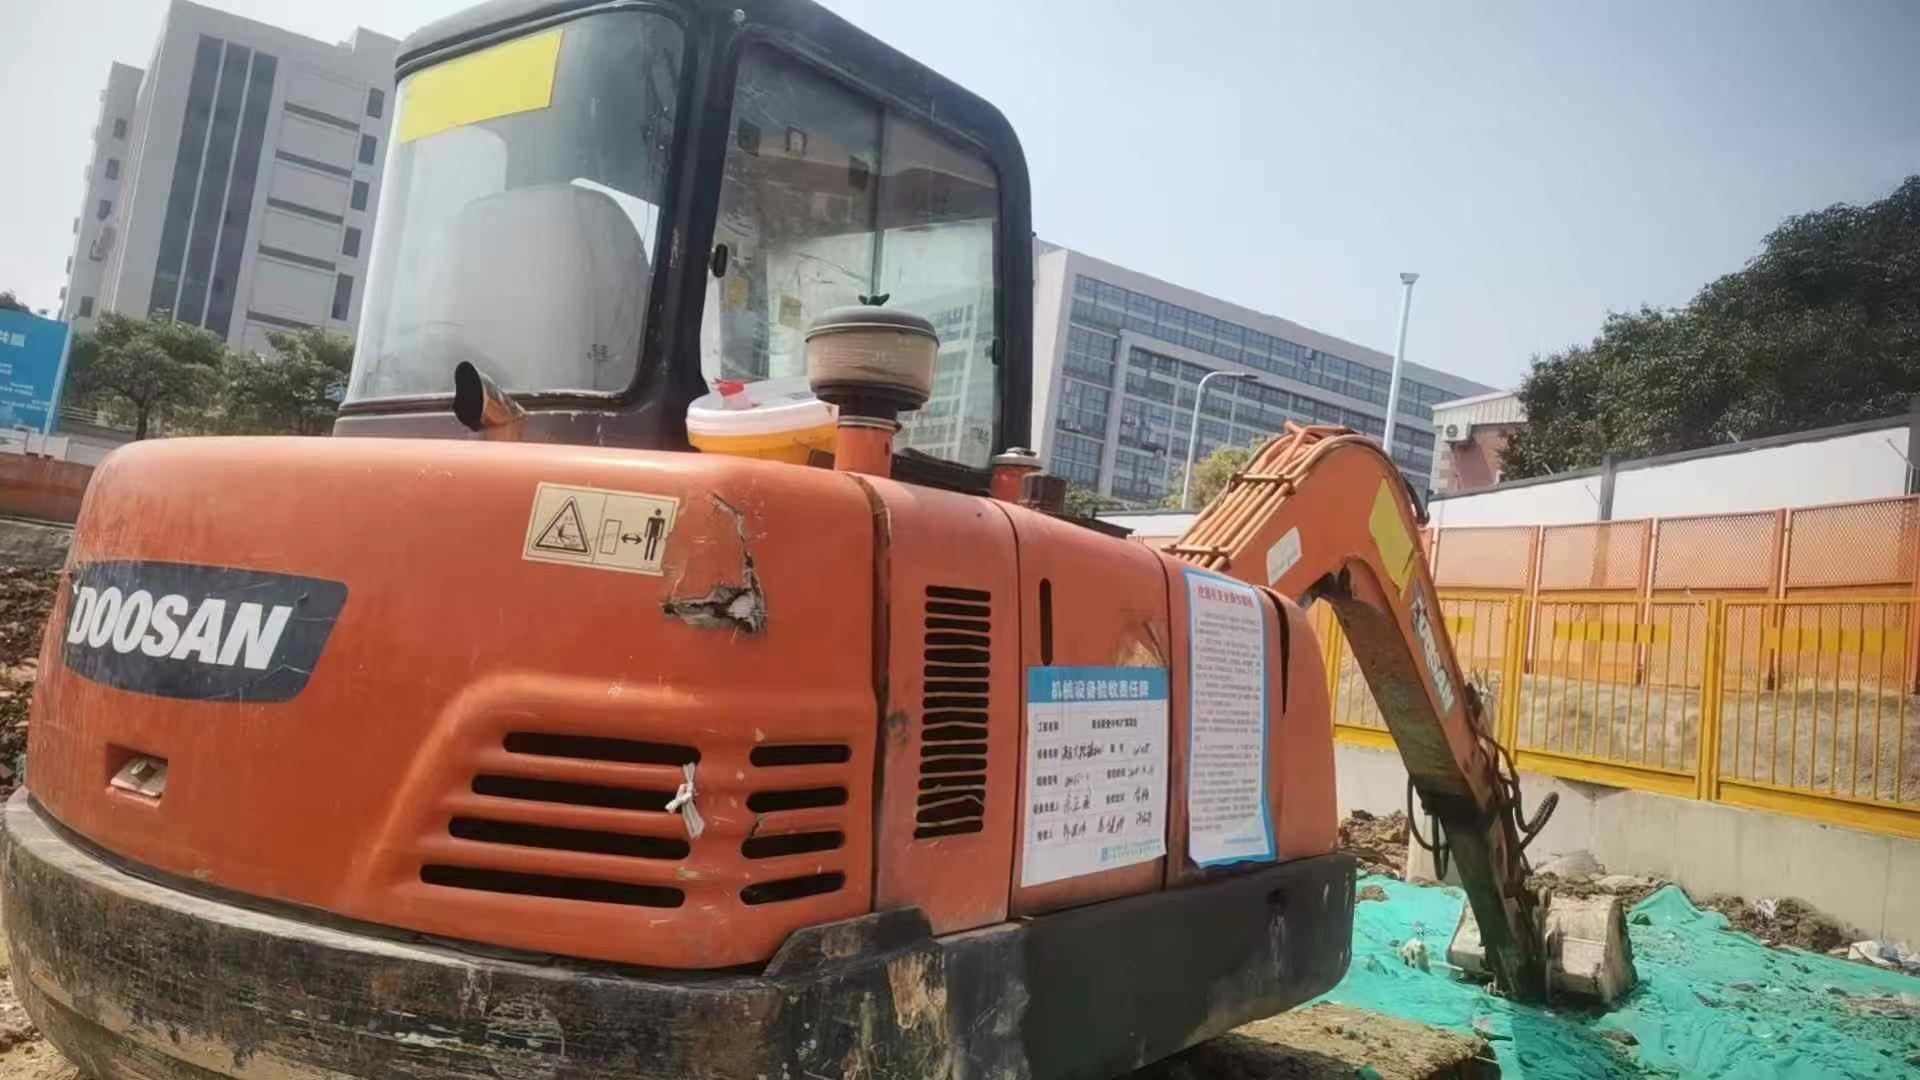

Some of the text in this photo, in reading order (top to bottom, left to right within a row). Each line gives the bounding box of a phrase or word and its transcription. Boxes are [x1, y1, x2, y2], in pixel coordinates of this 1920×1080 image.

[68, 585, 293, 671] DOOSAN
[1051, 680, 1150, 699] 机械设备验收责任牌
